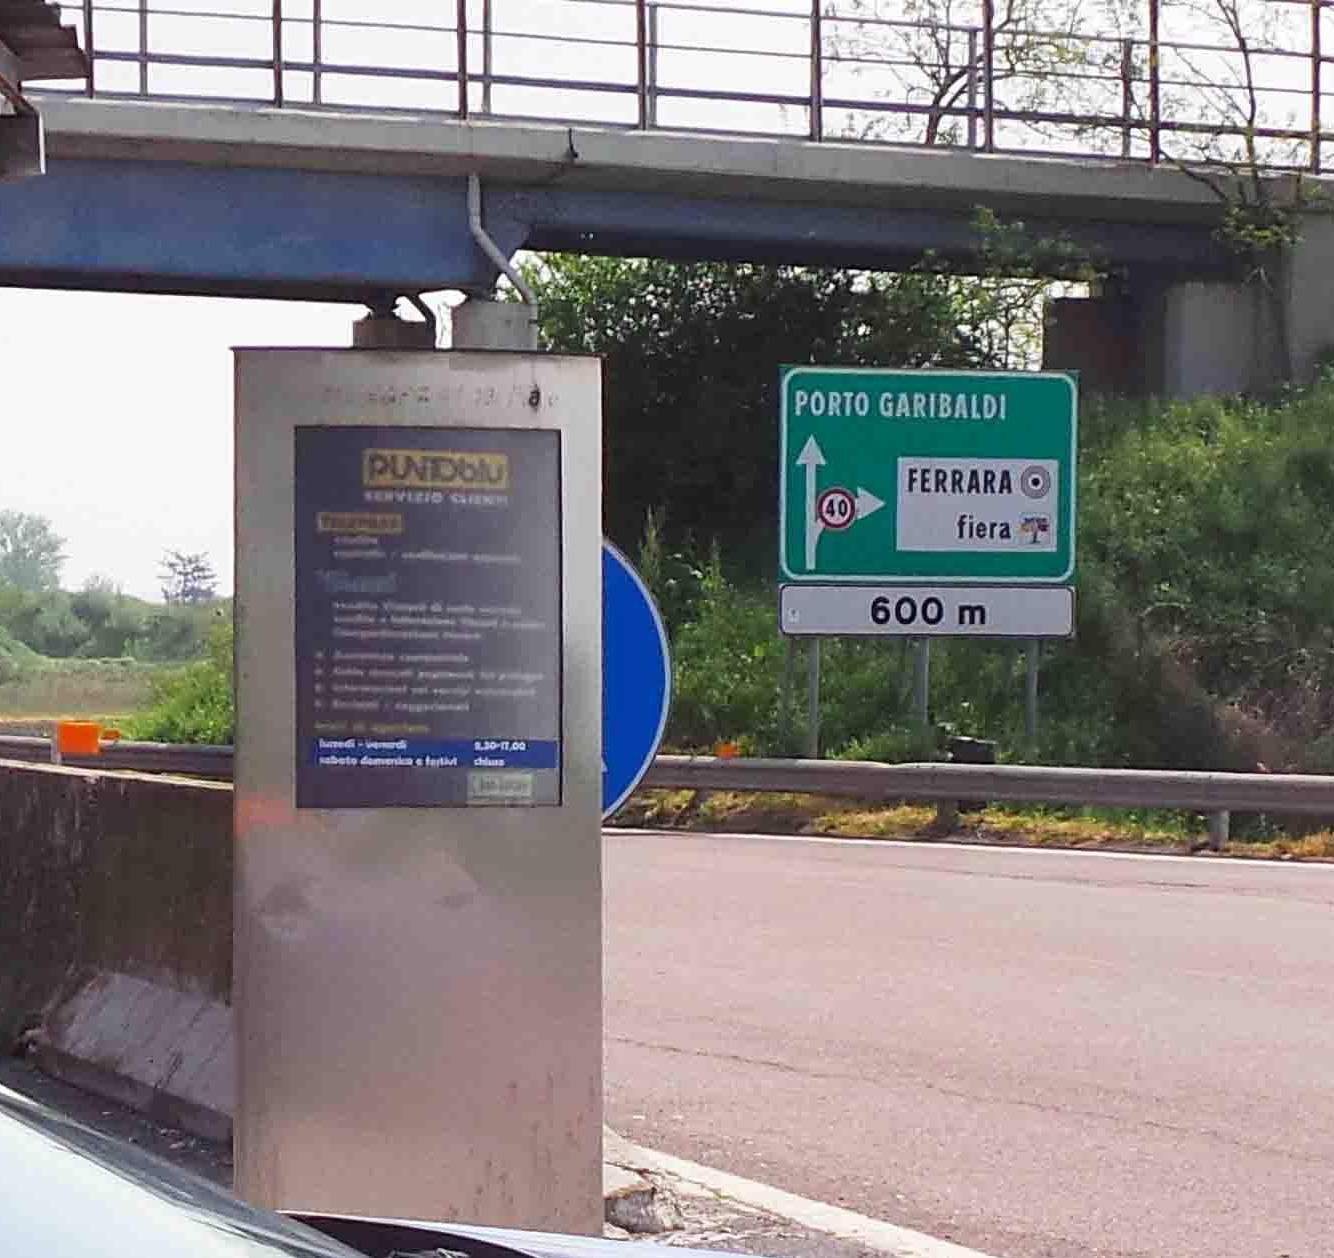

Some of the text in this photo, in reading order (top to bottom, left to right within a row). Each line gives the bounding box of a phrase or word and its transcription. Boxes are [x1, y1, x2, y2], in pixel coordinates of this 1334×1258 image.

[794, 390, 1007, 420] PORTO GARIBALDI
[907, 468, 1013, 495] FERRARA
[825, 499, 849, 518] 40
[956, 515, 1012, 540] fiera
[870, 597, 987, 625] 600 m
